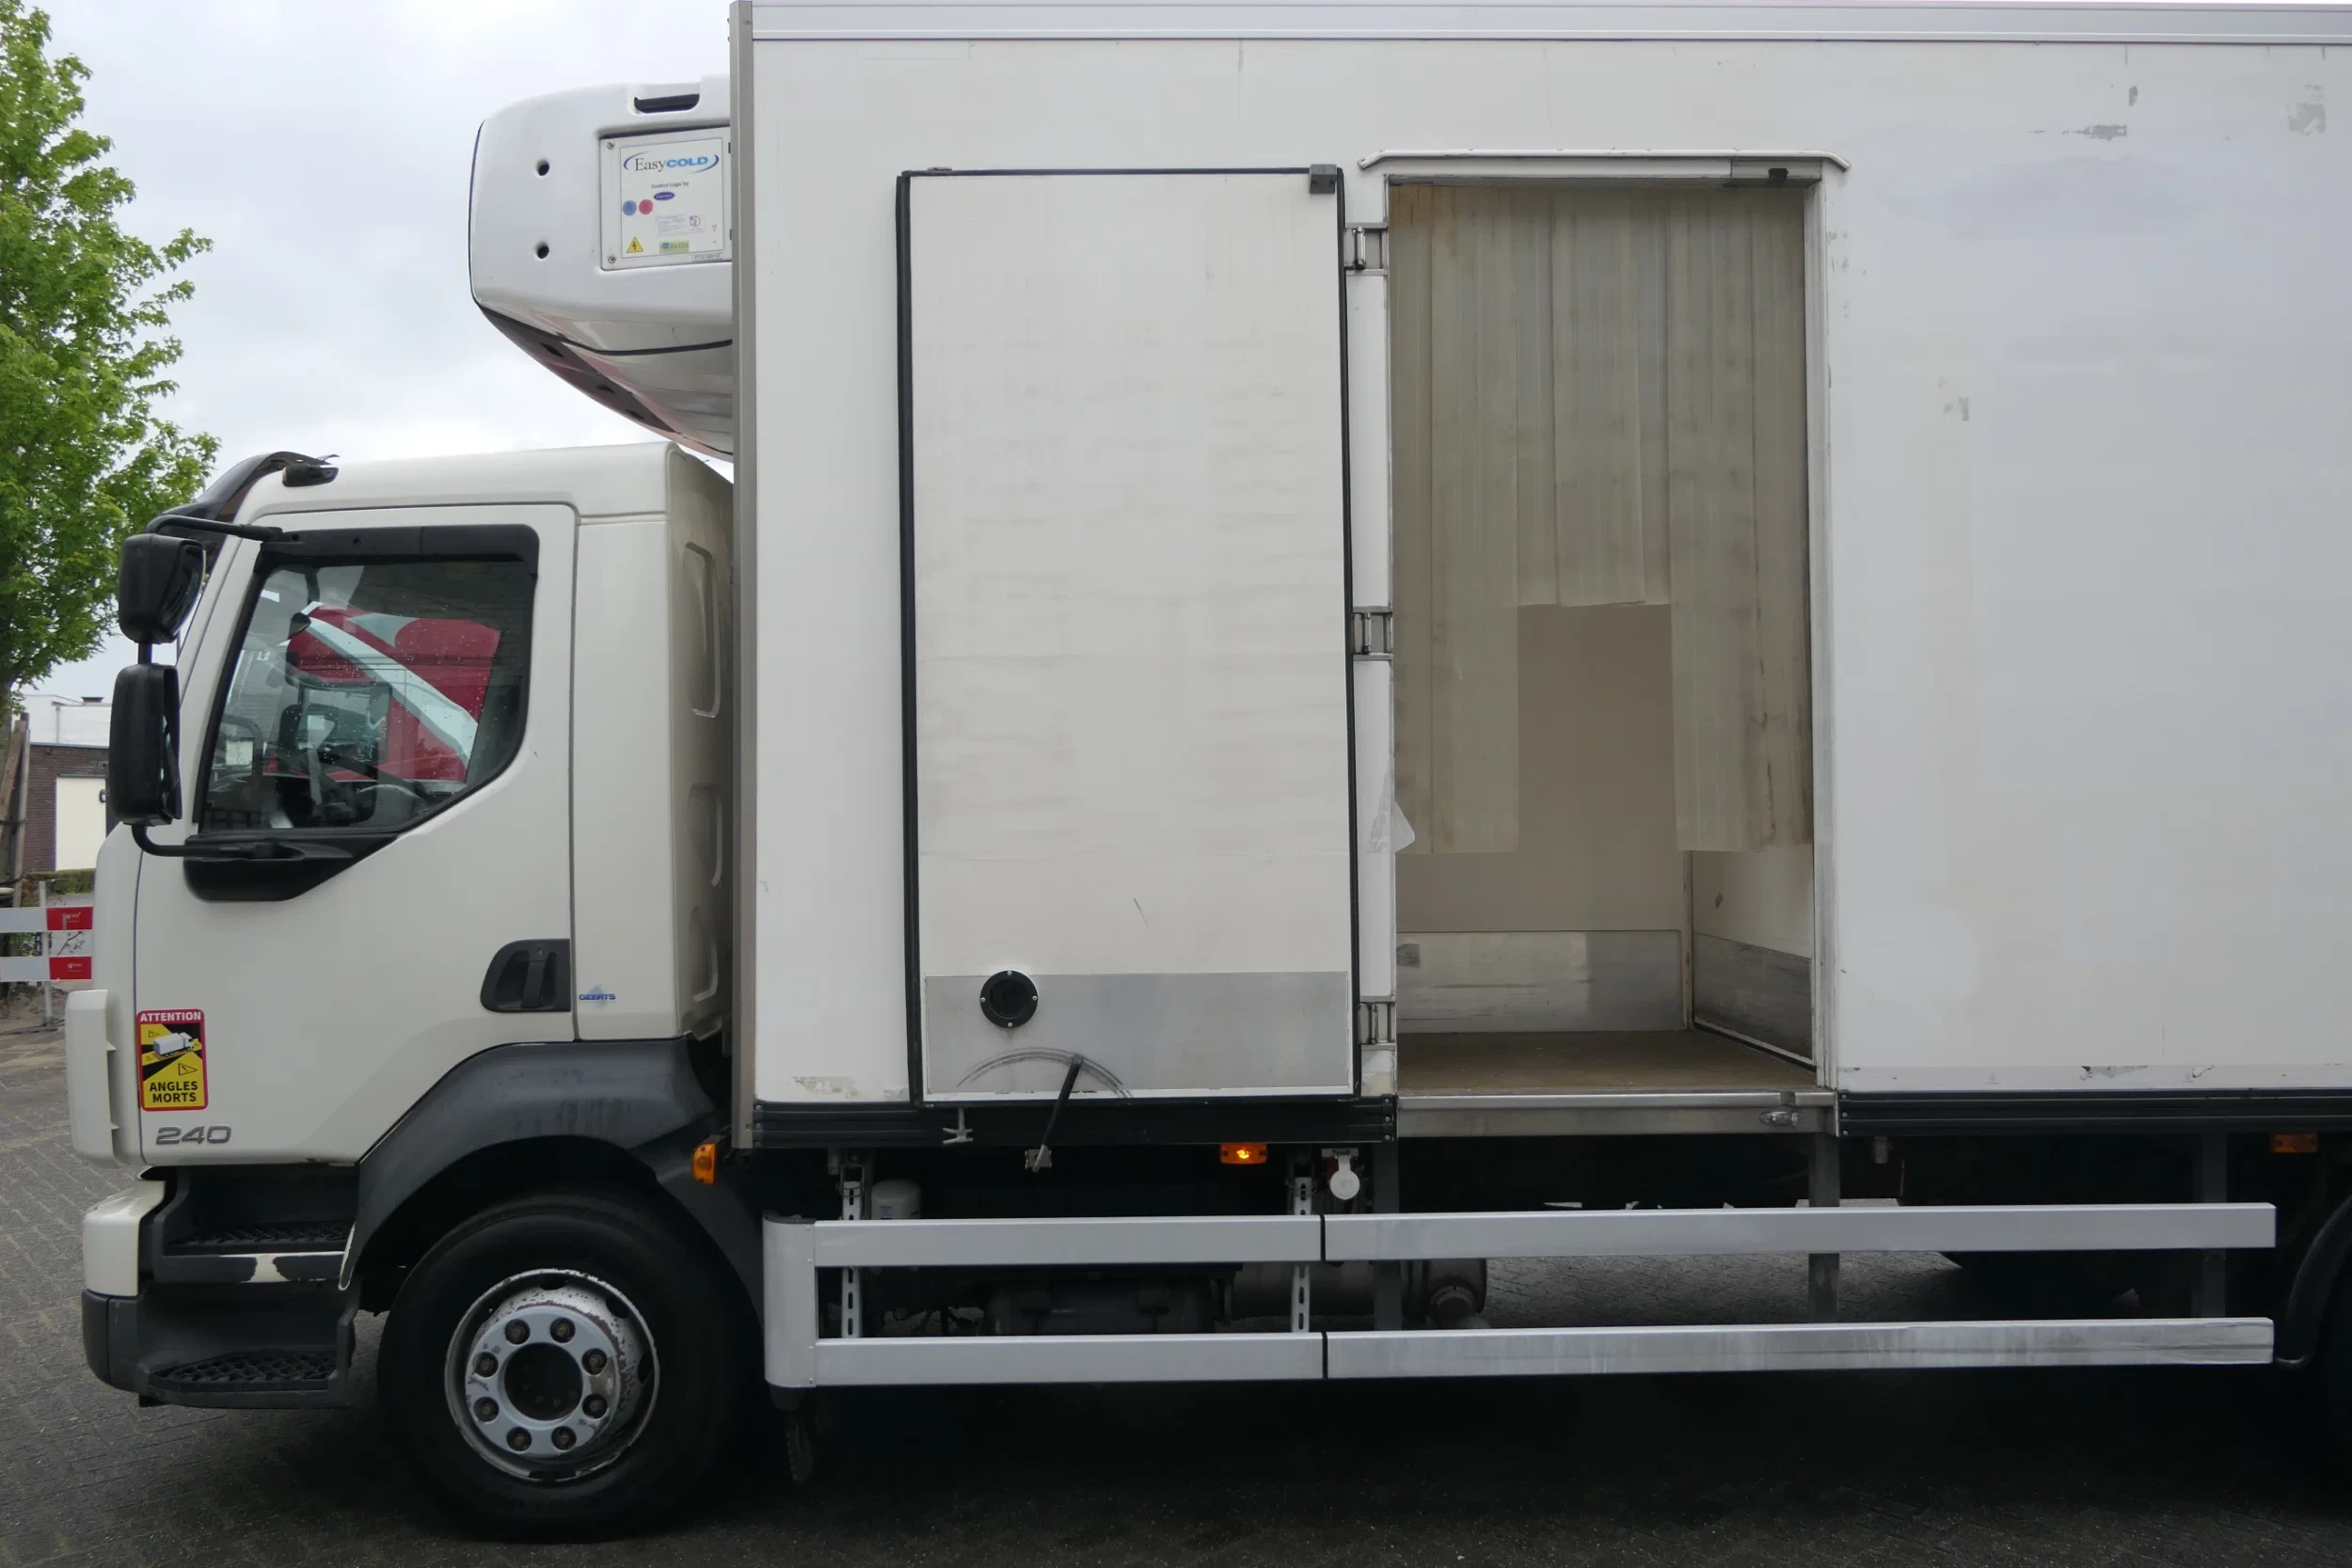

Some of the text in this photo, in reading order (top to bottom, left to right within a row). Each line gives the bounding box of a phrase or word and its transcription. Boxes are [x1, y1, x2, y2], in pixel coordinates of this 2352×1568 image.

[635, 156, 708, 172] EasyCOLD
[140, 1011, 201, 1022] ATTENTION
[150, 1081, 199, 1092] ANGLES
[152, 1092, 197, 1103] MORTS
[155, 1125, 232, 1145] 240
